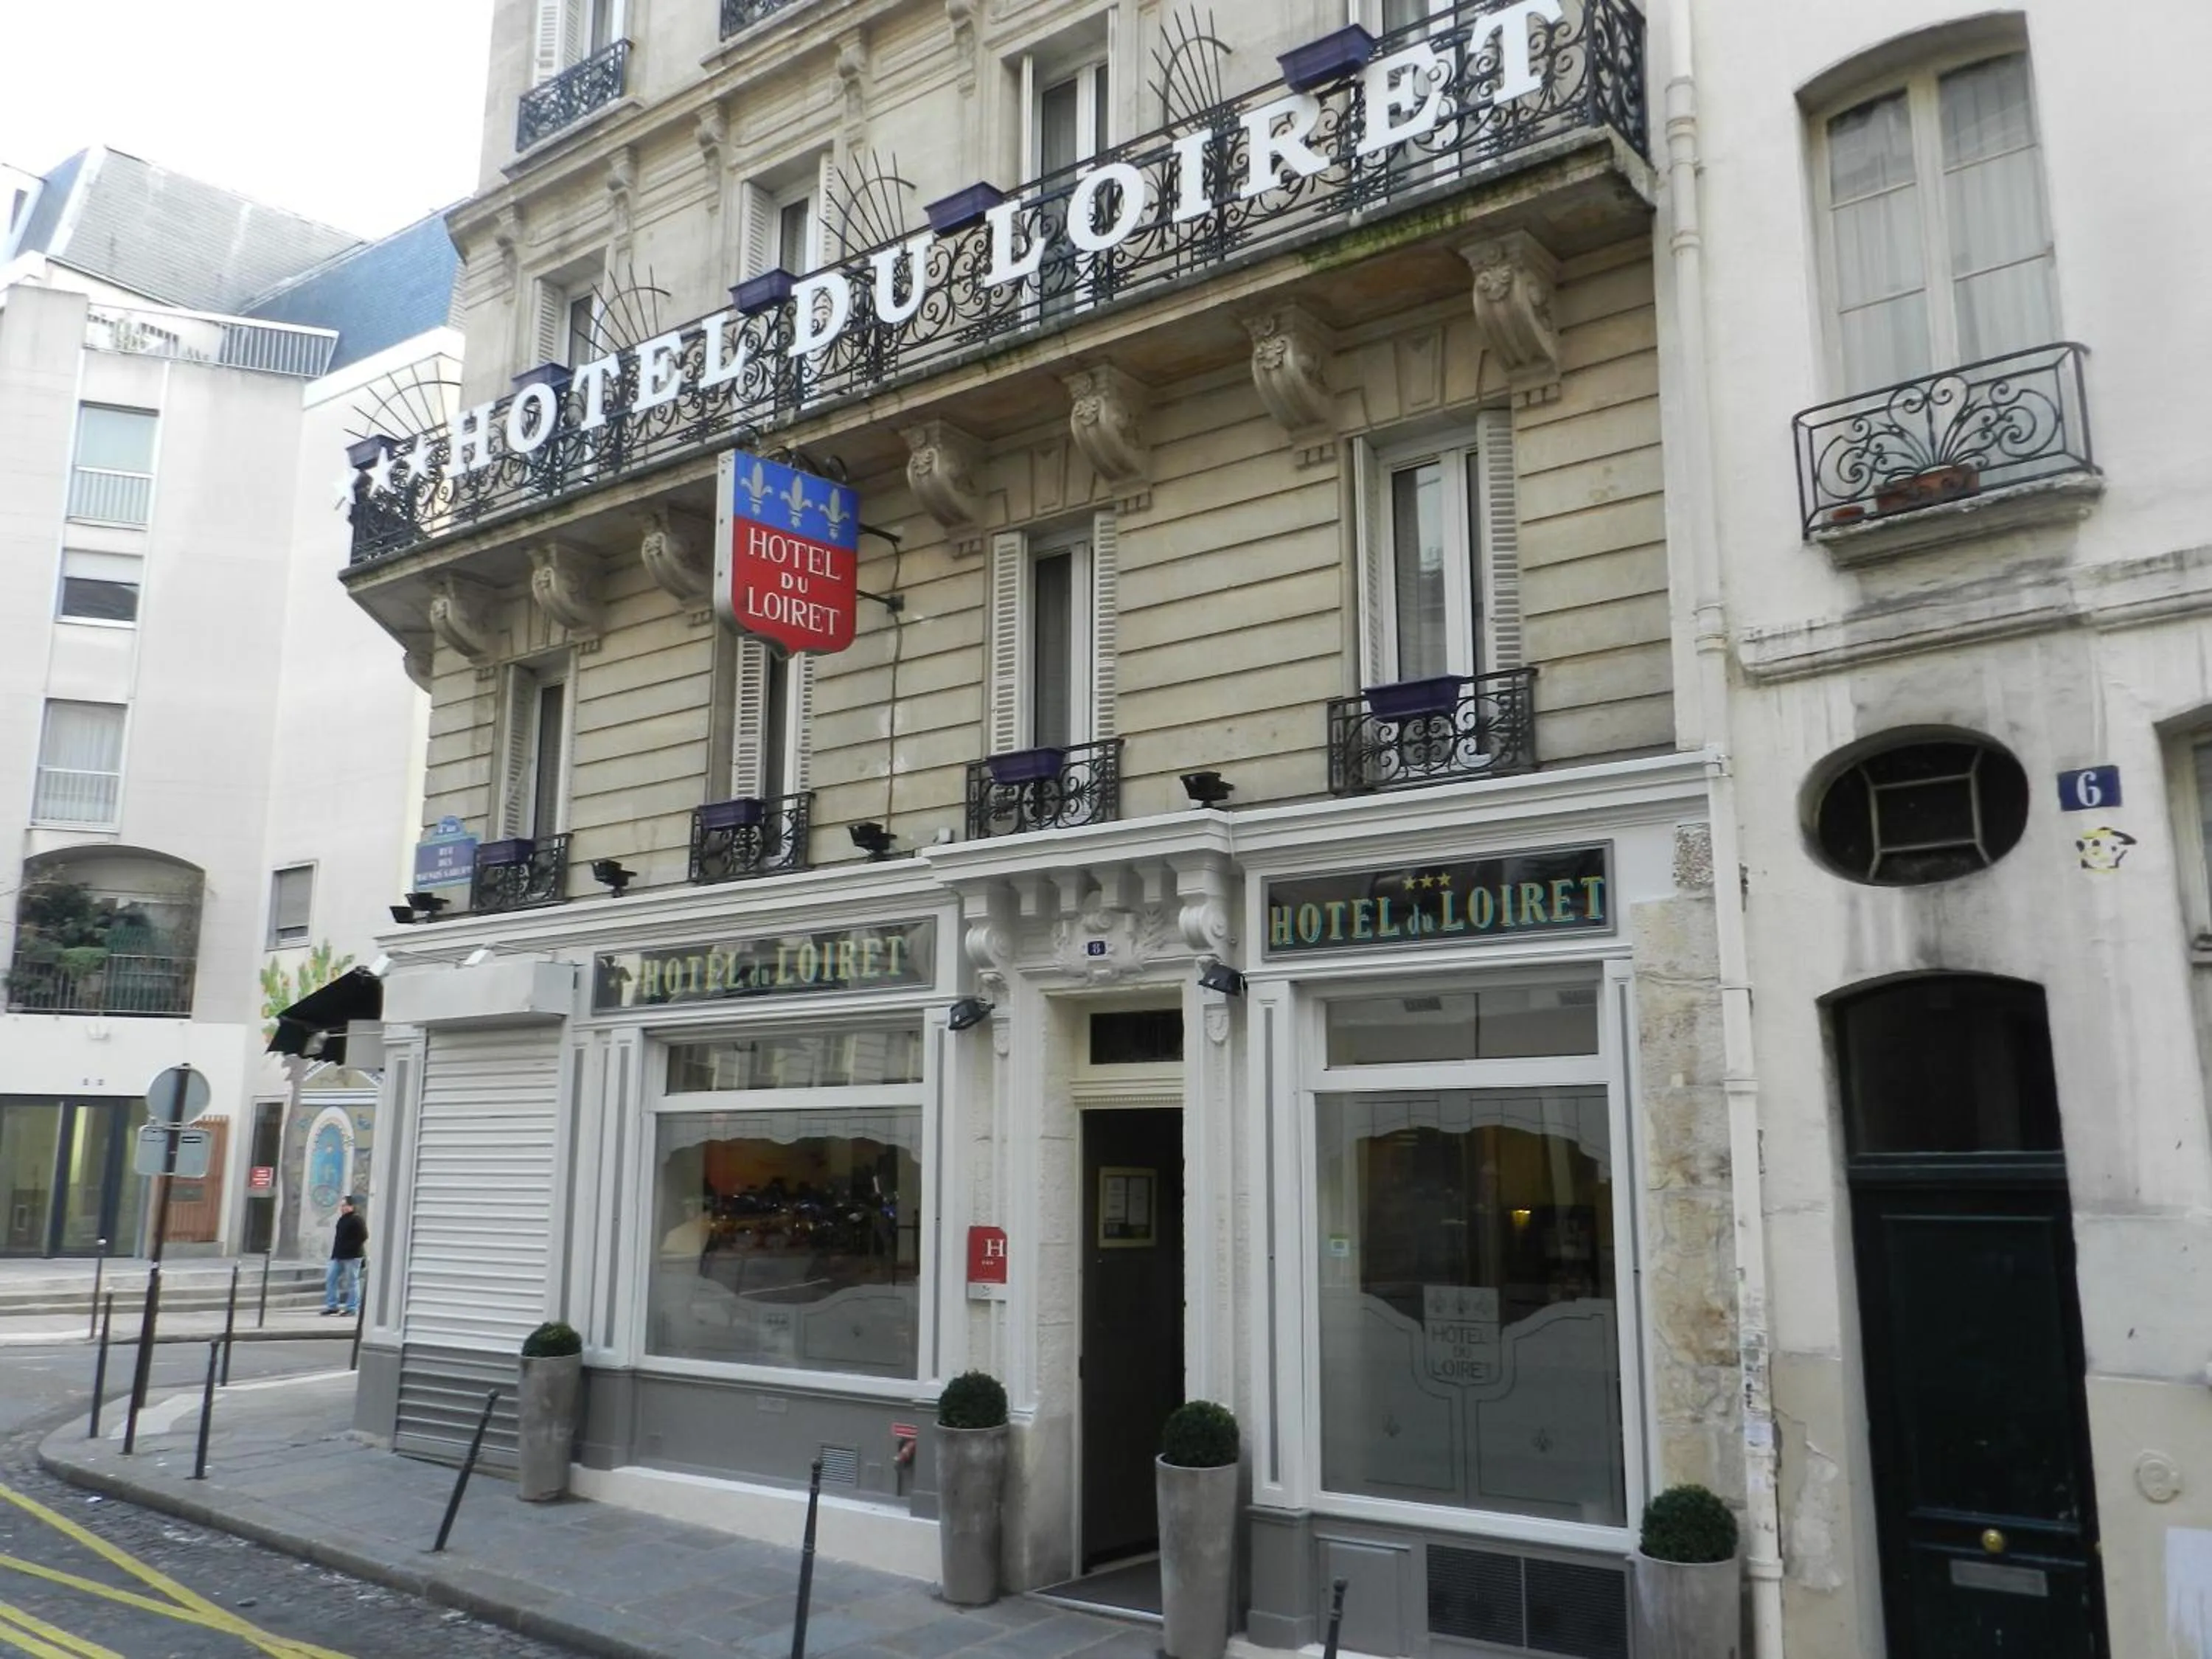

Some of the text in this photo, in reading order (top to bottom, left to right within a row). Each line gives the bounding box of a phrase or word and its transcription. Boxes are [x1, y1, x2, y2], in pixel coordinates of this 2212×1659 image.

[442, 0, 1563, 479] HOTEL DU LOIRET
[748, 527, 841, 580] HOTEL
[781, 572, 808, 594] DU
[747, 587, 841, 635] LOIRET
[2076, 771, 2101, 807] 6
[1270, 876, 1605, 946] HOTEL du LOIRET
[641, 935, 905, 997] HOTEL du LOIRET
[985, 1239, 1004, 1257] H
[1432, 1324, 1489, 1345] HOTEL
[1431, 1360, 1492, 1379] LOIRET
